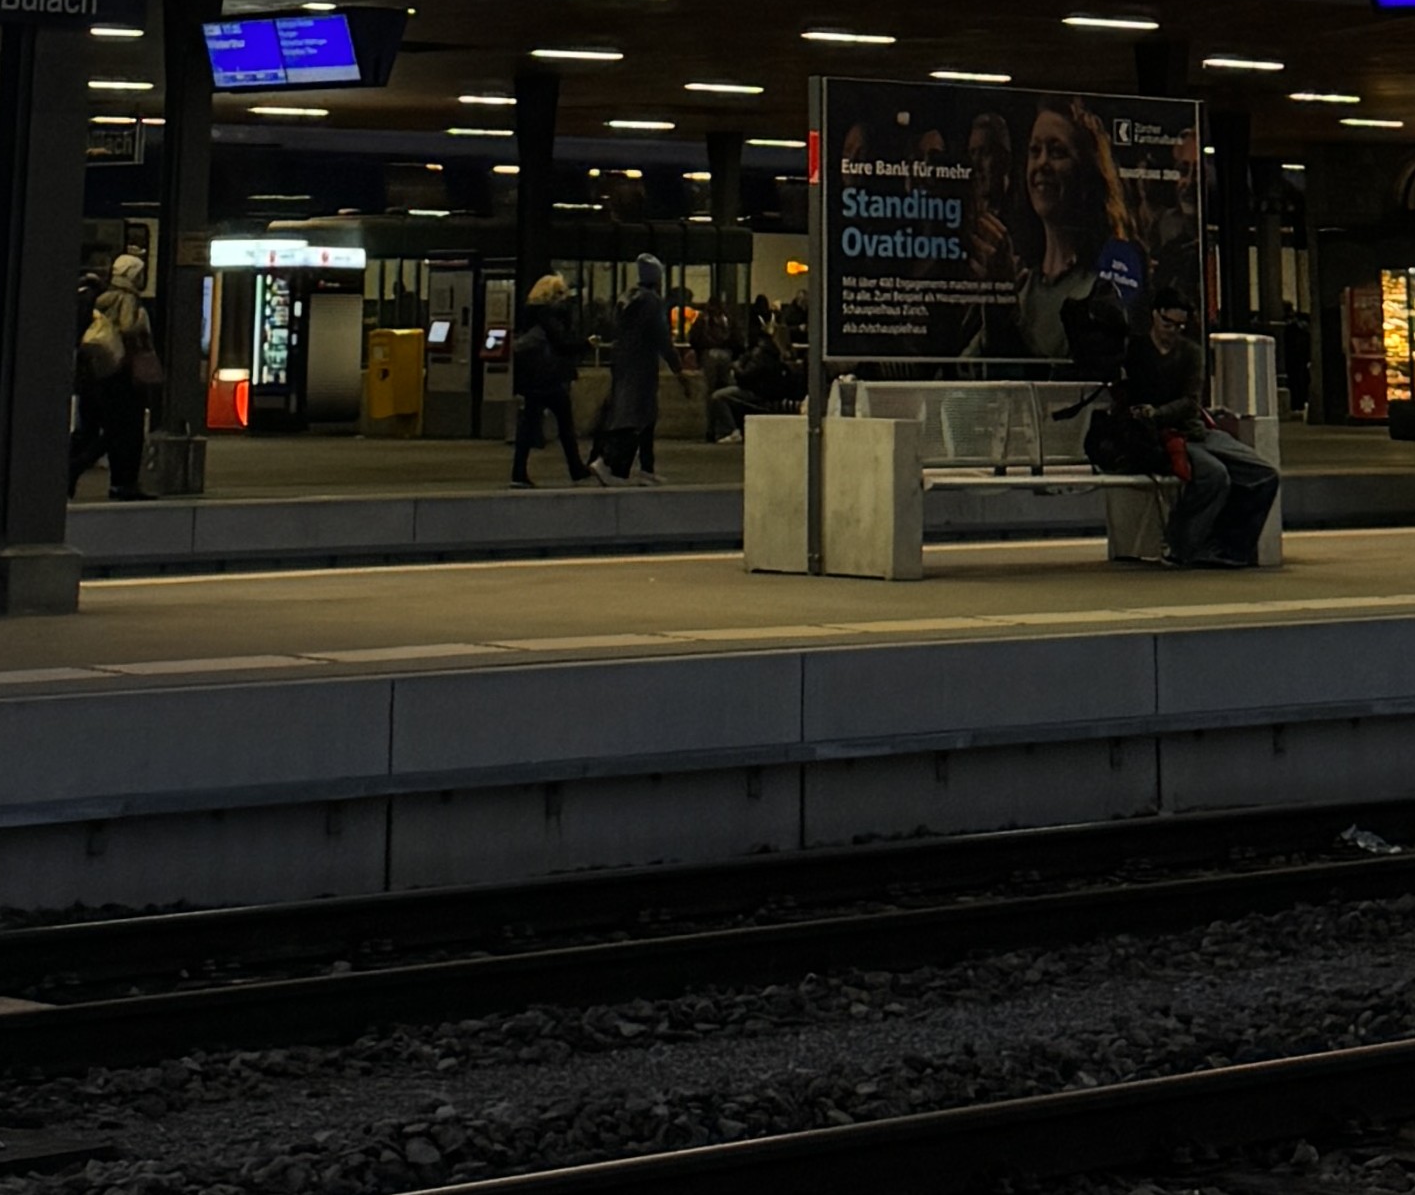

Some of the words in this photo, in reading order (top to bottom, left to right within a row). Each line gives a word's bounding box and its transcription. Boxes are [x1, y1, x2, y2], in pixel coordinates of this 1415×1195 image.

[841, 158, 873, 176] Eure
[875, 159, 910, 177] Bank
[912, 160, 934, 178] für
[935, 163, 973, 180] mehr
[841, 187, 963, 229] Standing
[841, 226, 969, 261] Ovations.
